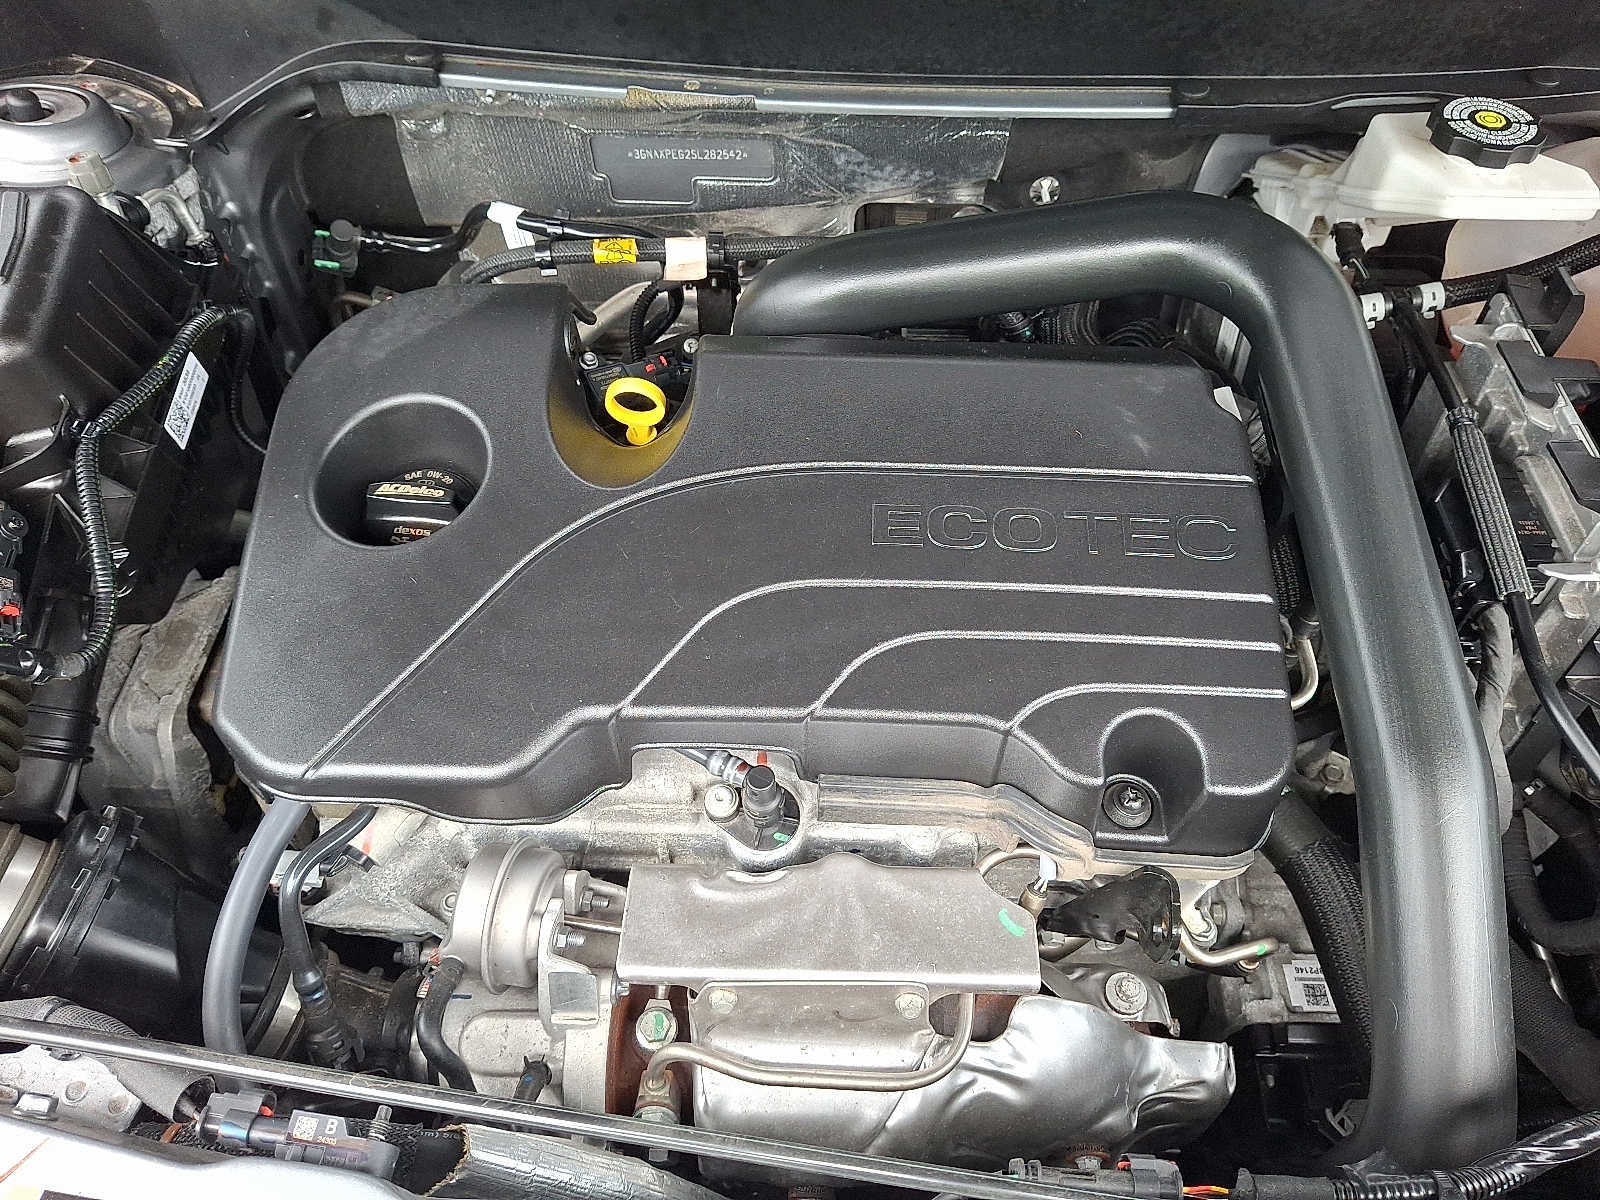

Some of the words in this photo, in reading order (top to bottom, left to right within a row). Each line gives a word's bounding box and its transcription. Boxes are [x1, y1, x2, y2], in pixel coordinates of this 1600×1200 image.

[404, 470, 423, 480] SAE
[375, 483, 445, 498] ACDelco
[393, 525, 431, 537] dexos
[871, 502, 1237, 561] ECOTEC
[324, 1118, 339, 1135] B
